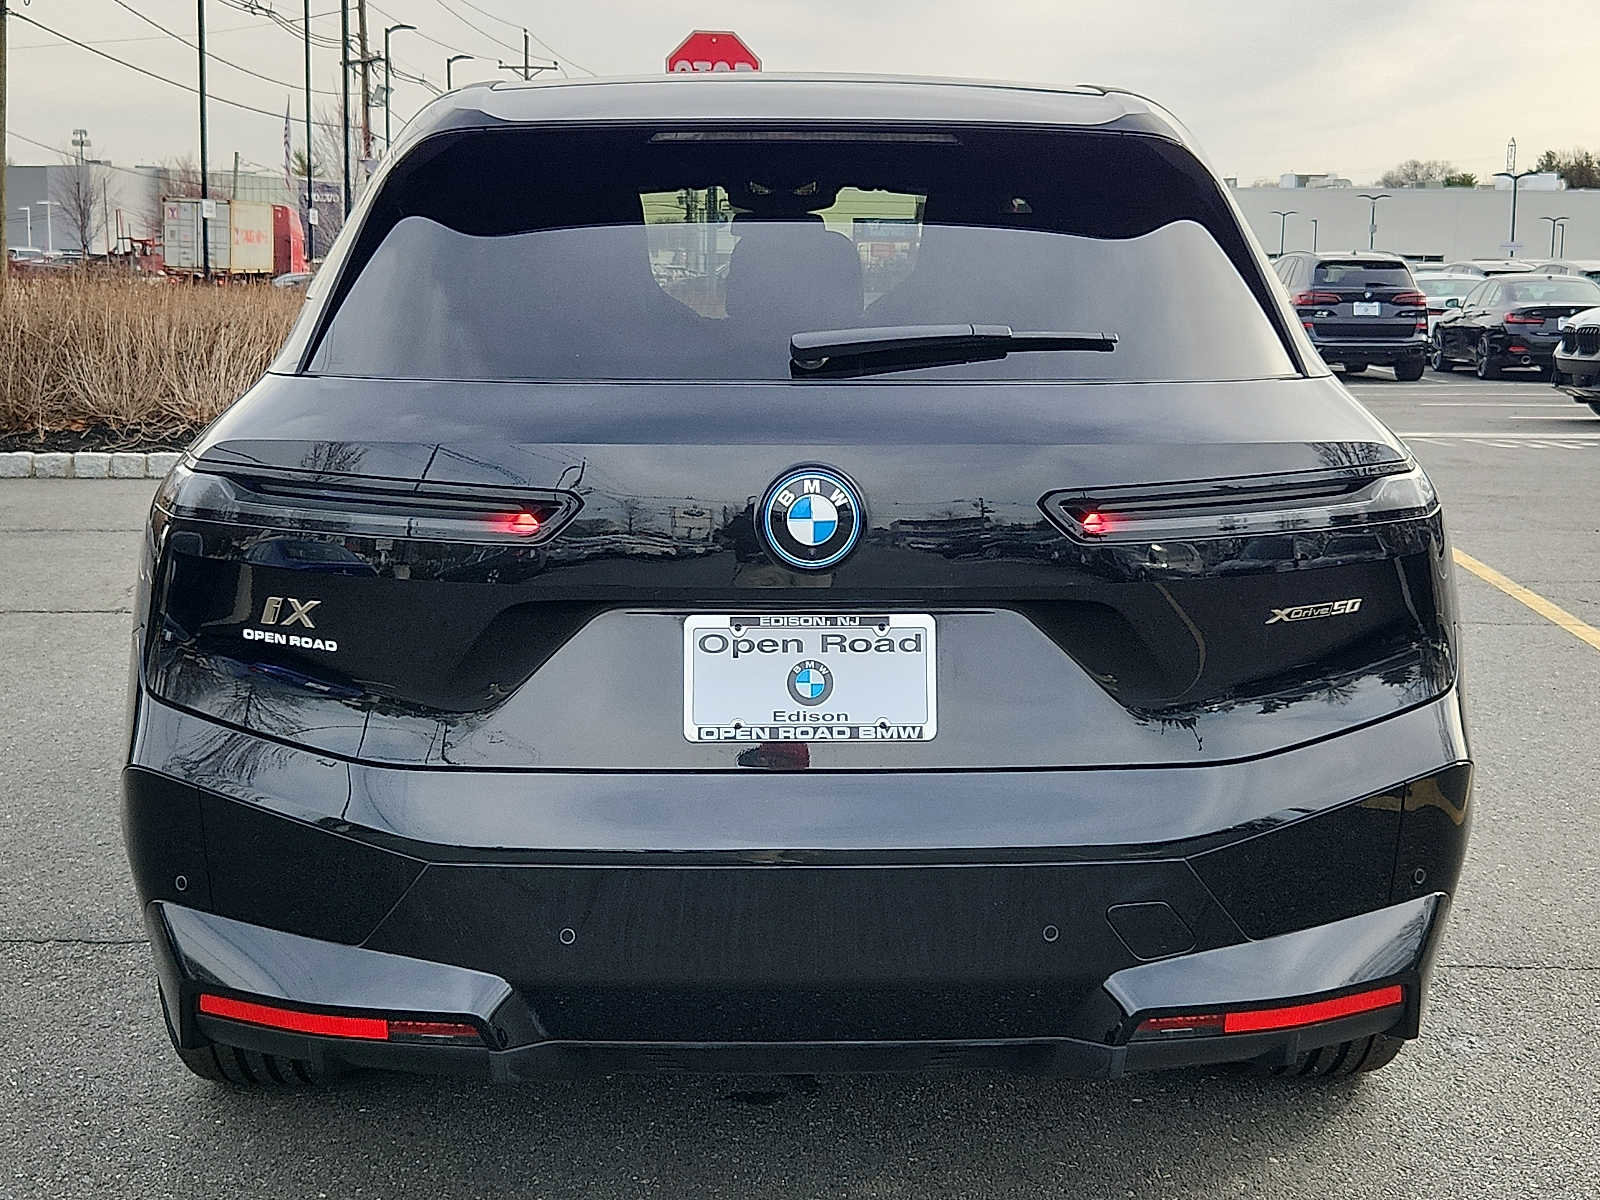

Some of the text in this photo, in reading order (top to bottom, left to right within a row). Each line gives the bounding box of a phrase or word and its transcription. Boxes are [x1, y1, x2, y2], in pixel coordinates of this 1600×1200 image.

[777, 479, 848, 507] BMW
[261, 597, 321, 628] iX
[760, 616, 860, 627] EDISON, NJ
[242, 628, 338, 652] OPEN ROAD
[699, 633, 922, 658] Open Road
[792, 660, 829, 675] BMW
[773, 711, 849, 722] Edison
[700, 727, 921, 740] OPEN ROAD BMW
